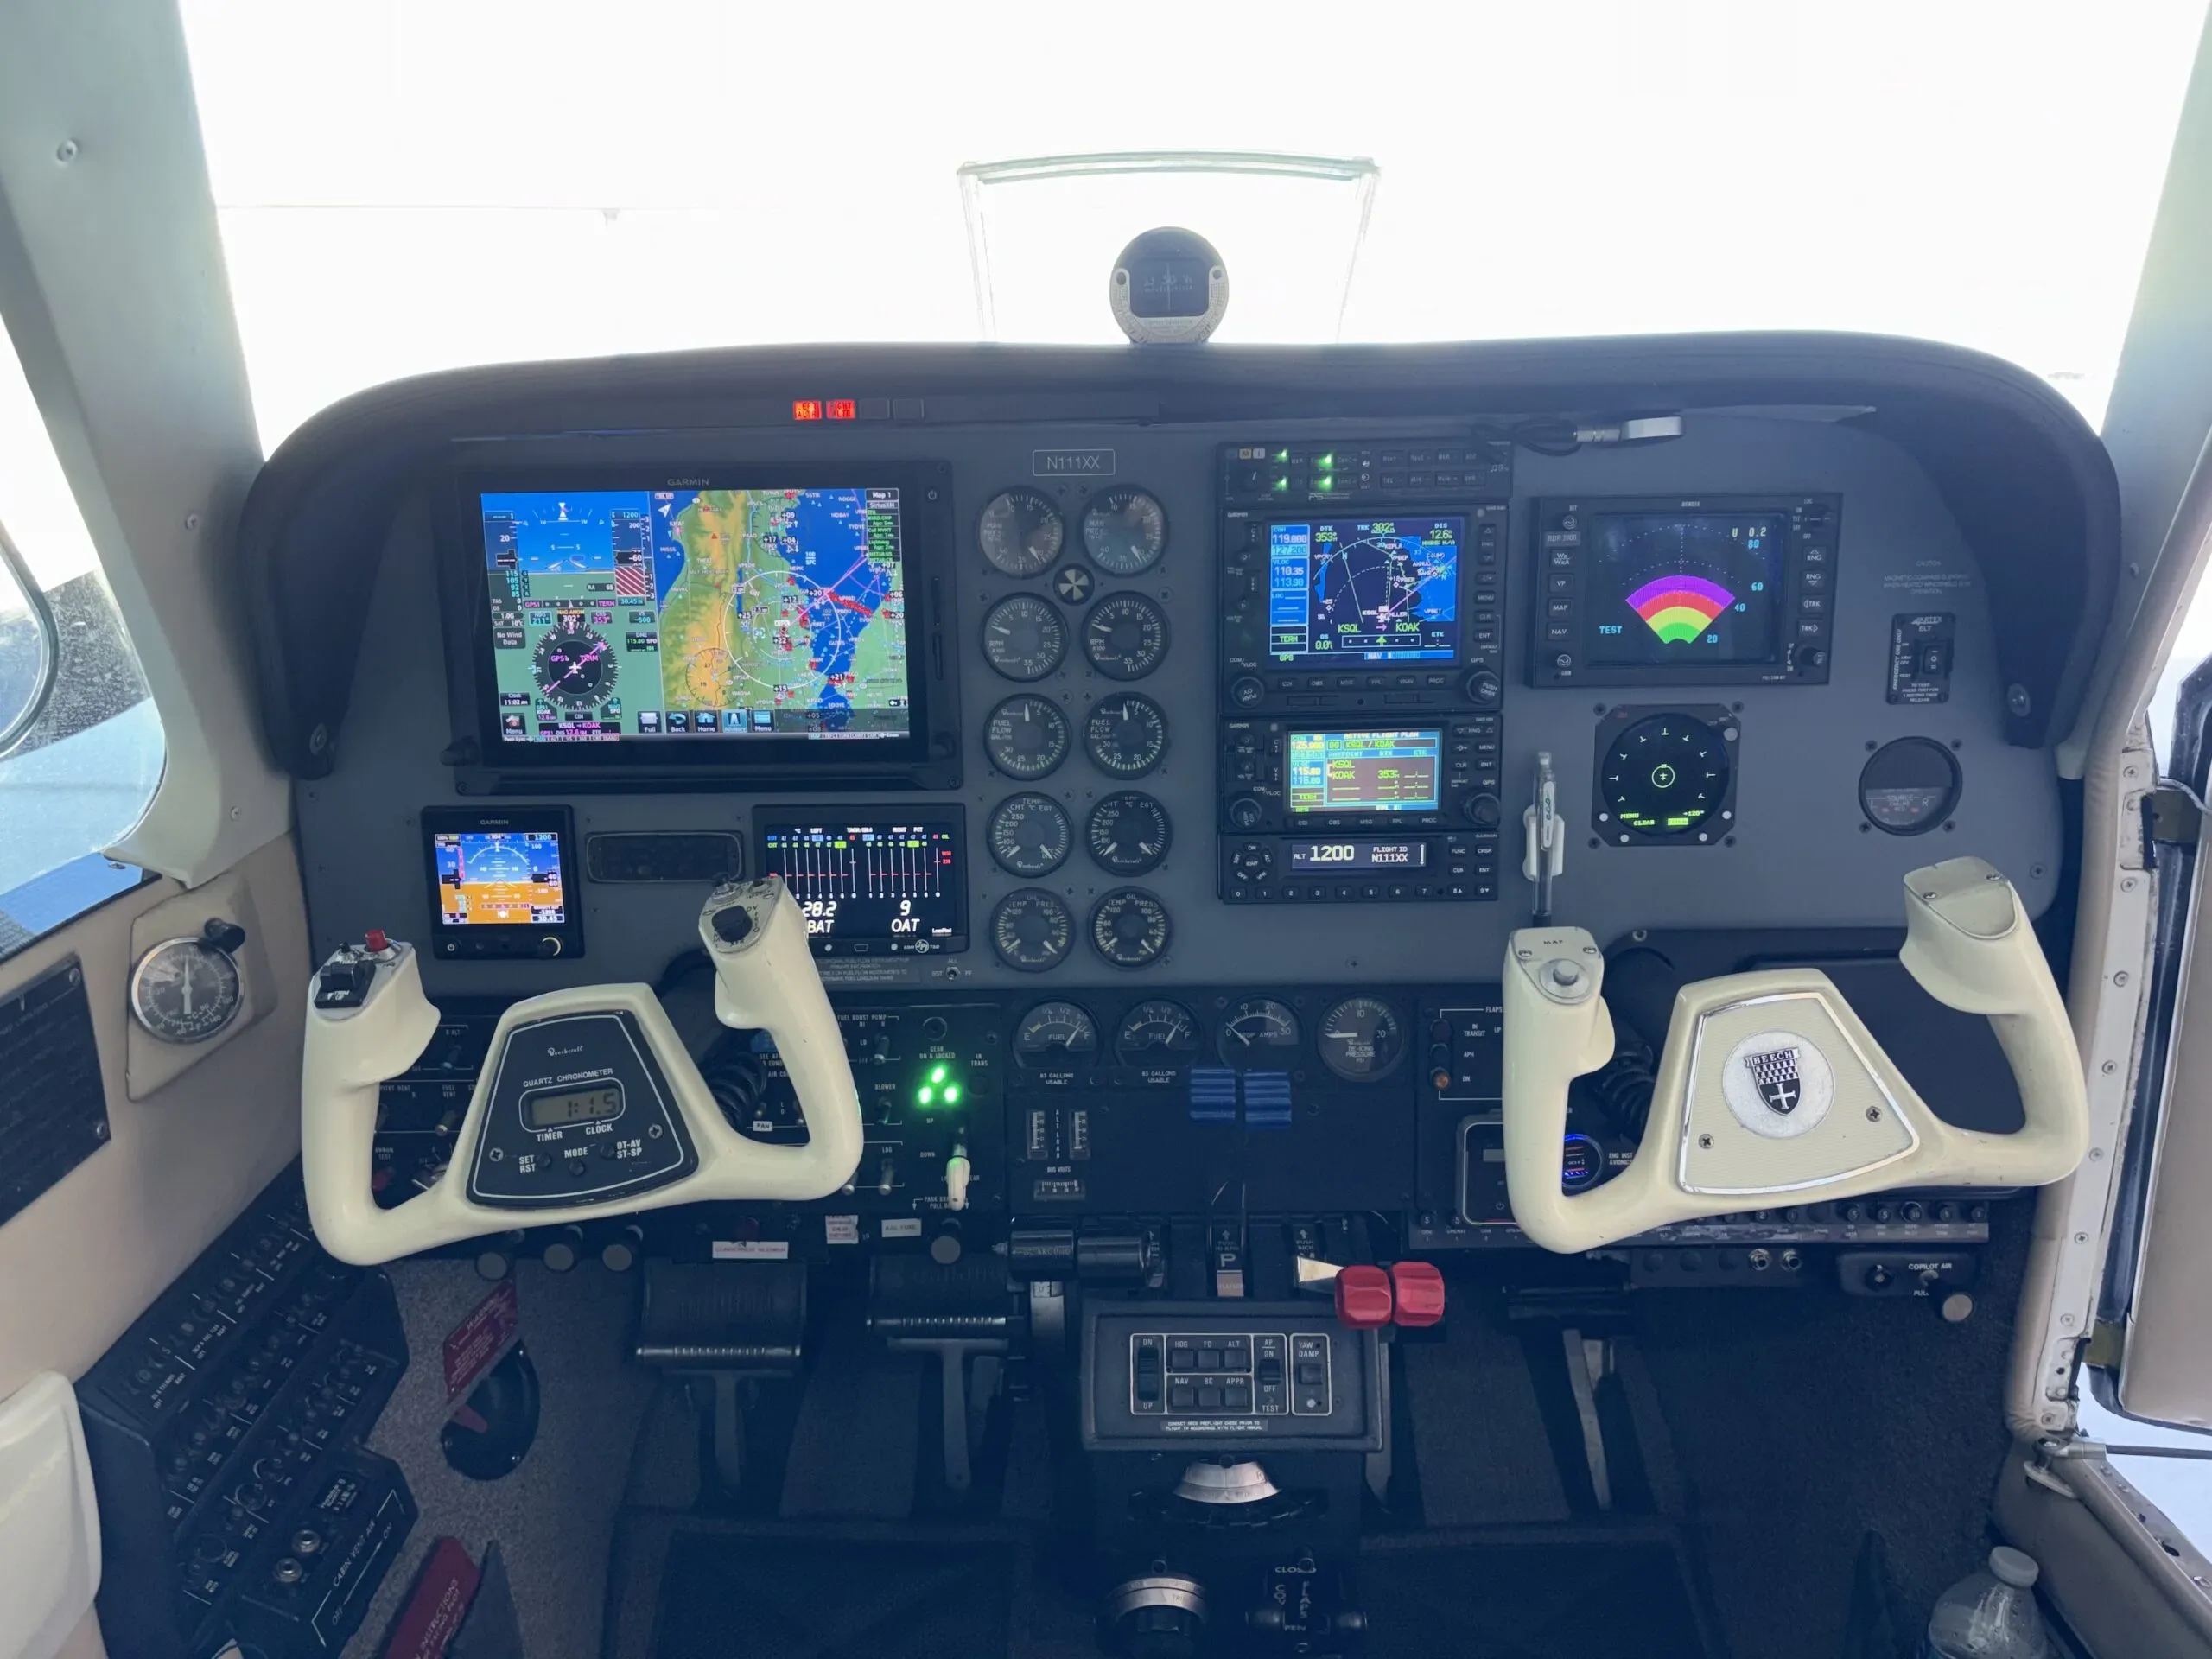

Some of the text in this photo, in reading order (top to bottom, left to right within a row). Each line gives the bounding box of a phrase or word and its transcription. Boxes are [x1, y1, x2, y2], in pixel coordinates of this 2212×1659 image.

[1046, 455, 1101, 470] N111XX
[1749, 527, 1767, 537] 0.2
[1748, 540, 1759, 549] 80
[1751, 582, 1764, 591] 60
[1734, 603, 1745, 612] 40
[1338, 623, 1420, 633] KSQL KOAK
[1599, 626, 1623, 634] TEST
[1707, 634, 1718, 643] 20
[1310, 845, 1355, 861] 1200
[1371, 854, 1408, 862] N111XX
[802, 900, 911, 917] 28.2 9
[891, 918, 920, 932] OAT
[1753, 1051, 1793, 1064] BEECH
[523, 1067, 613, 1087] QUARTZ CHRONOMETER
[586, 1124, 613, 1135] CLOCK
[537, 1131, 563, 1142] TIMER
[617, 1140, 641, 1149] DT-AV
[564, 1147, 588, 1158] MODE
[617, 1147, 642, 1159] ST-SP
[519, 1155, 534, 1165] SET
[519, 1164, 536, 1173] RST
[1220, 1254, 1236, 1267] P
